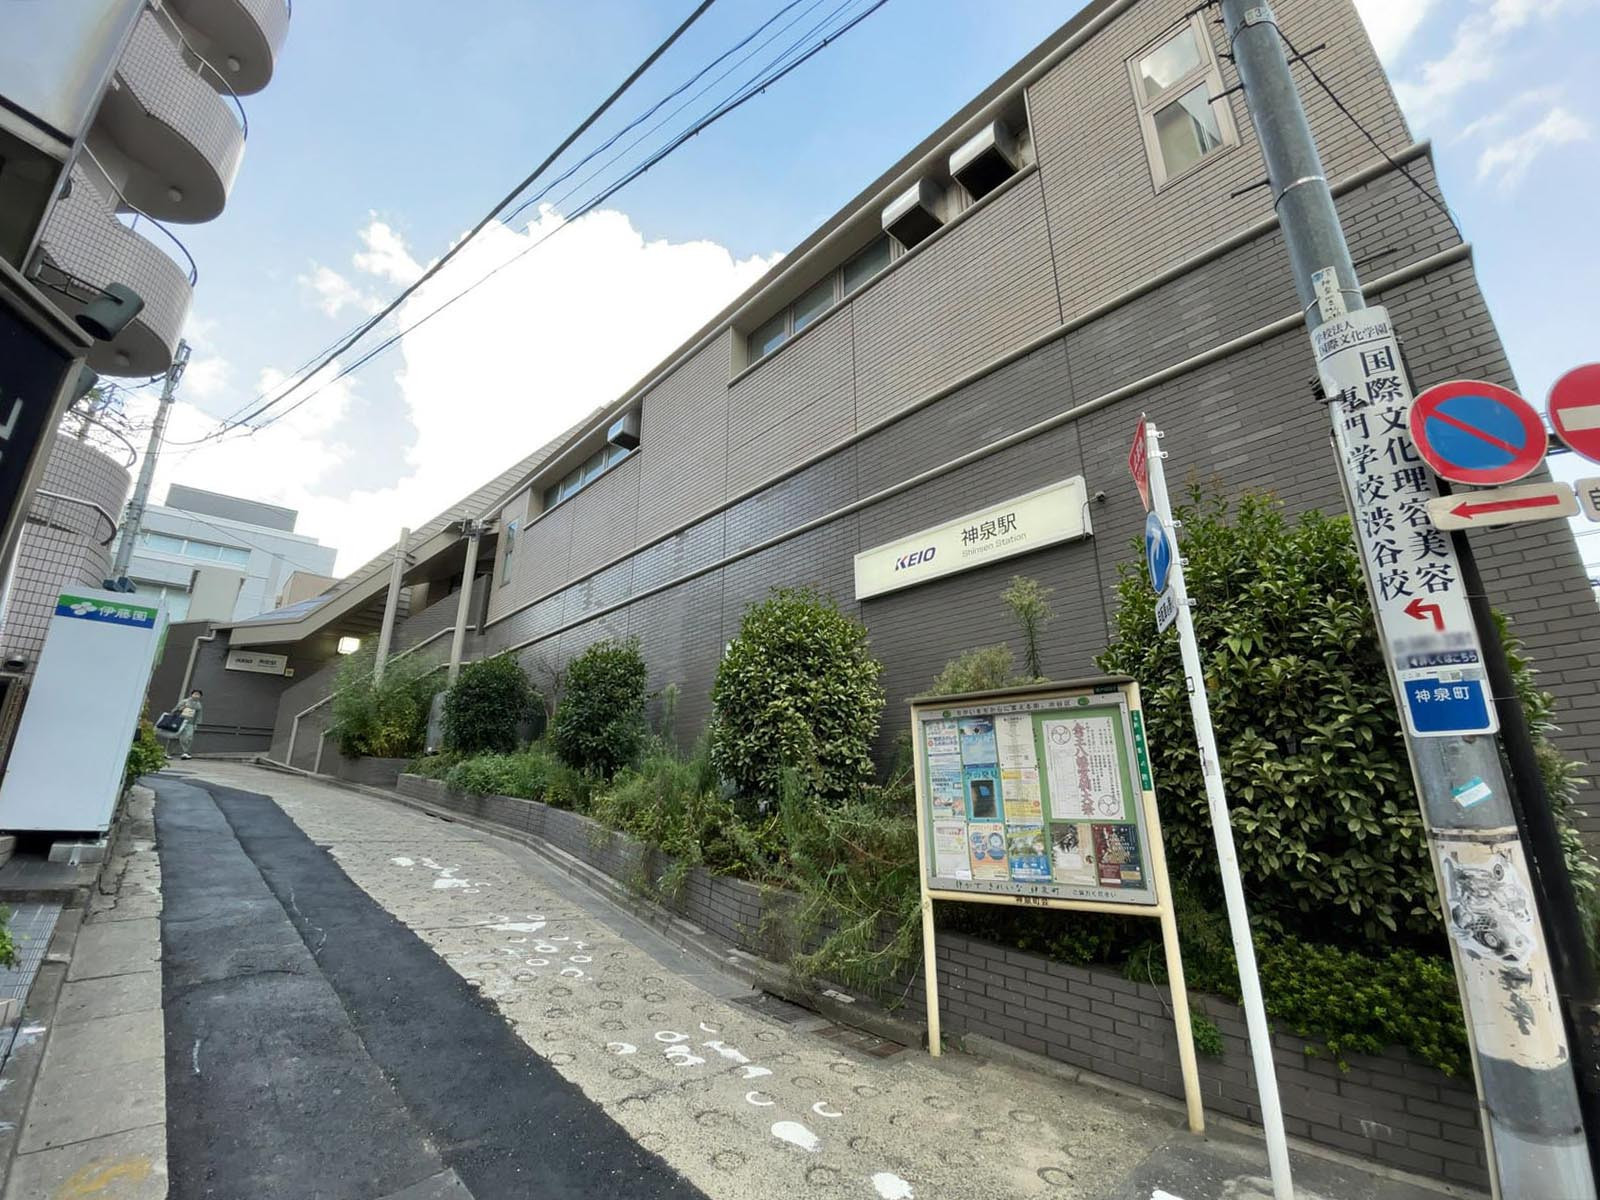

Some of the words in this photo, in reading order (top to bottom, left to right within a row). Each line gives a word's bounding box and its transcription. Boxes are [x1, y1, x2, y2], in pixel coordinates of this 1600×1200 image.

[1359, 345, 1455, 594] 国際文化理容美容
[960, 512, 1018, 547] 神泉駅
[961, 542, 994, 558] Shinsen
[995, 532, 1028, 548] Station
[895, 546, 937, 571] KEIO
[99, 605, 148, 622] 伊藤園
[1414, 686, 1470, 703] 神泉町
